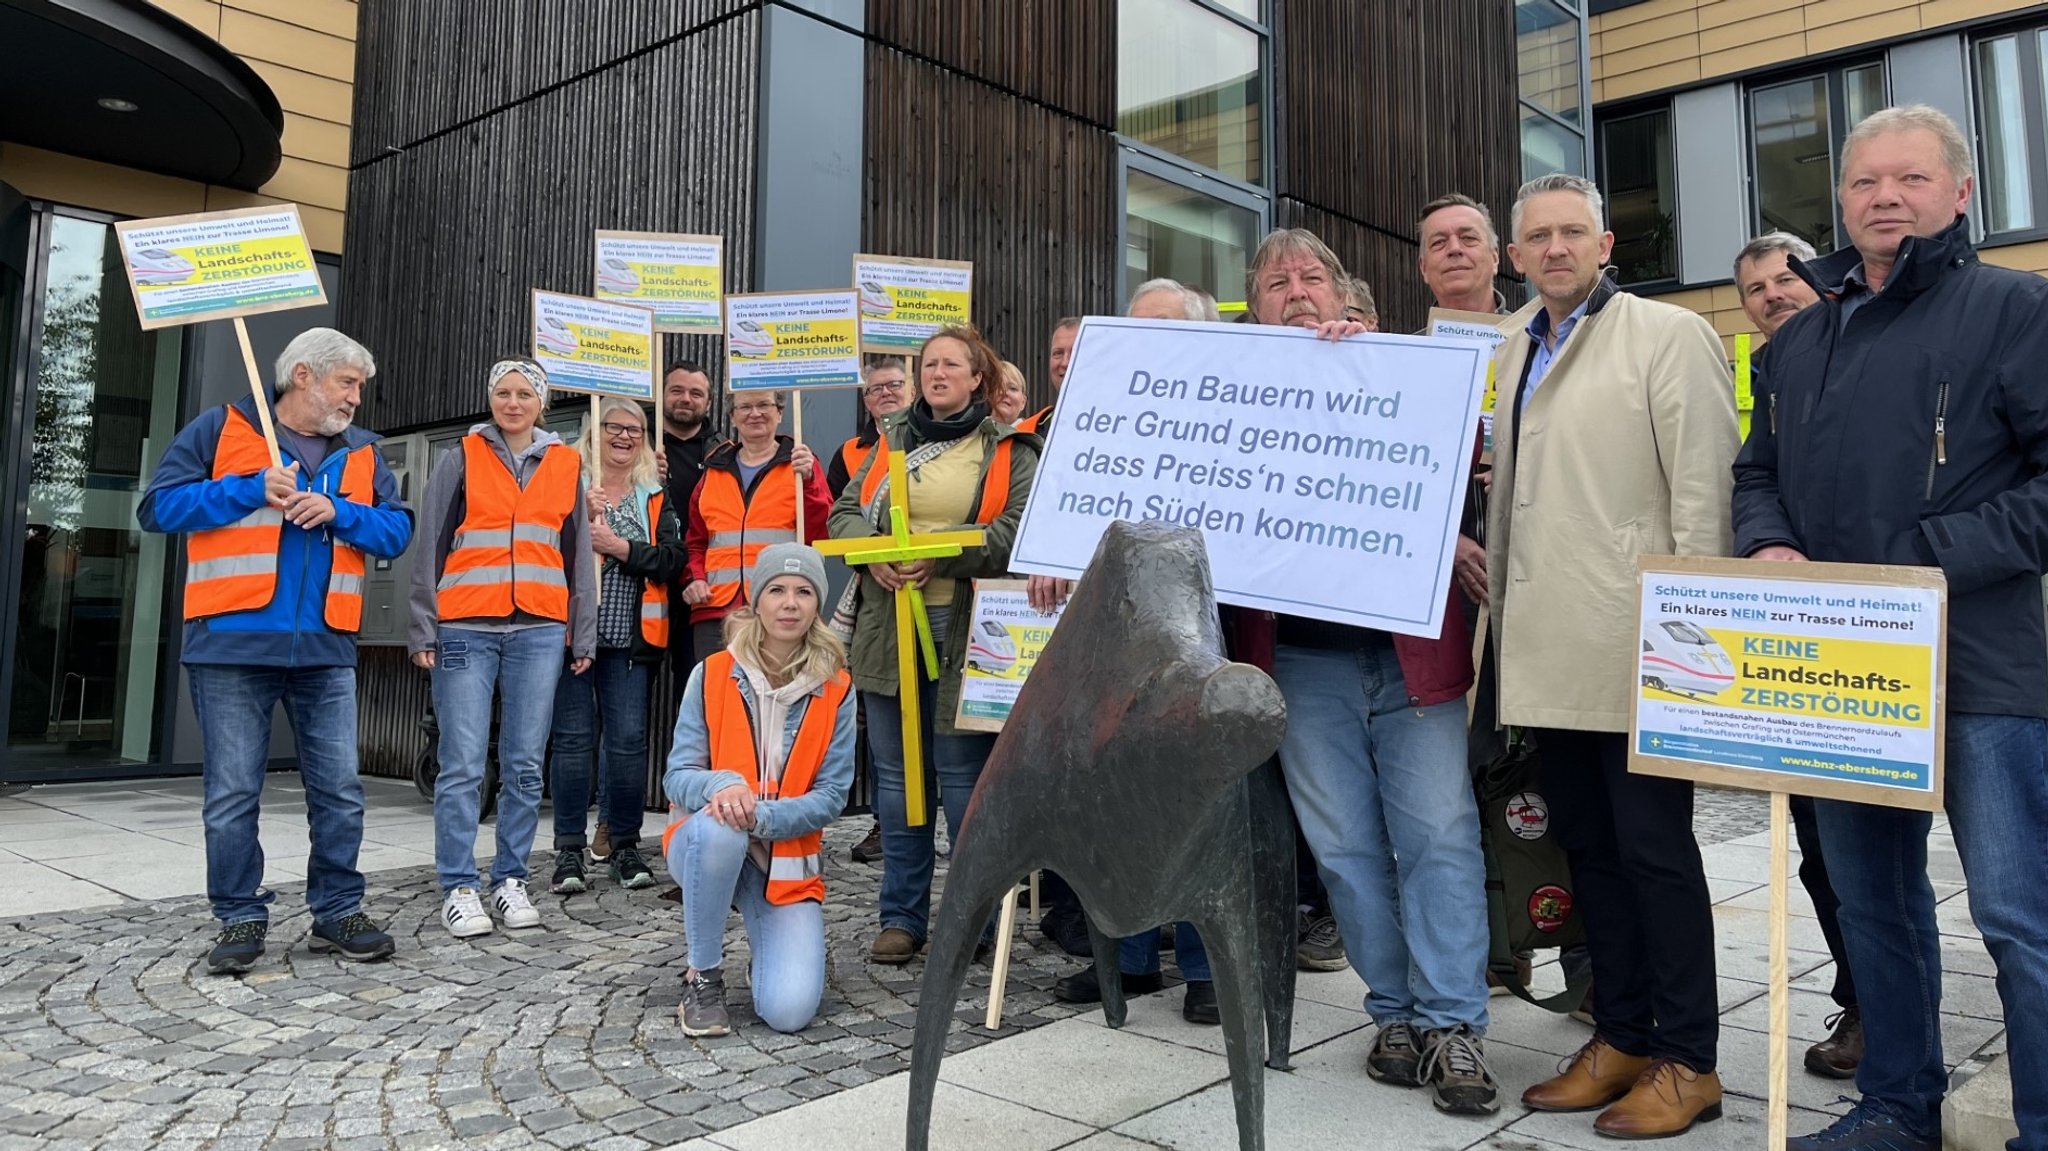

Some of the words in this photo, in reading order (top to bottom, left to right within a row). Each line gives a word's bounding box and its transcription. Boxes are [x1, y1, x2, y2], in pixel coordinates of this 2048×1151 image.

[128, 231, 164, 239] Schützt
[200, 223, 235, 231] Umwelt
[256, 217, 290, 225] Heimat!
[151, 237, 180, 245] klares
[223, 229, 252, 237] Trasse
[254, 225, 289, 233] Limone!
[194, 244, 242, 257] KEINE
[198, 249, 297, 269] Landschafts-
[200, 258, 307, 281] ZERSTÖRUNG
[643, 265, 675, 274] KEINE
[643, 277, 712, 287] Landschafts-
[643, 287, 716, 298] ZERSTÖRUNG
[897, 289, 928, 299] KEINE
[897, 300, 961, 312] Landschafts-
[580, 327, 610, 339] KEINE
[776, 323, 810, 333] KEINE
[1437, 325, 1474, 336] Schützt
[581, 339, 643, 356] Landschafts-
[777, 334, 848, 345] Landschafts-
[580, 349, 647, 368] ZERSTÖRUNG
[777, 344, 853, 357] ZERSTÖRUNG
[1128, 370, 1188, 400] Den
[1197, 376, 1314, 411] Bauern
[1325, 388, 1402, 420] wird
[1075, 405, 1128, 435] der
[1134, 410, 1232, 446] Grund
[1237, 426, 1440, 474] genommen,
[1073, 446, 1145, 478] dass
[1295, 472, 1424, 513] schnell
[1058, 491, 1133, 520] nach
[1142, 494, 1245, 535] Süden
[1254, 507, 1413, 559] kommen.
[981, 595, 1009, 604] Schützt
[1655, 586, 1707, 598] Schützt
[1711, 591, 1759, 602] unsere
[1764, 593, 1821, 606] Umwelt
[1827, 597, 1856, 608] und
[1861, 599, 1922, 613] Heimat!
[983, 608, 994, 616] Ein
[995, 608, 1018, 617] klares
[1020, 610, 1038, 619] NEIN
[1661, 603, 1683, 614] Ein
[1685, 605, 1727, 617] klares
[1731, 608, 1766, 621] NEIN
[1770, 613, 1793, 622] zur
[1798, 613, 1846, 626] Trasse
[1851, 617, 1914, 631] Limone!
[1024, 629, 1051, 642] KEIN
[1743, 637, 1819, 660] KEINE
[1743, 662, 1911, 694] Landschafts-
[1741, 684, 1921, 722] ZERSTÖRUNG
[1702, 710, 1764, 723] bestandsnahen
[1766, 717, 1798, 727] Ausbau
[1800, 721, 1815, 729] des
[1817, 722, 1901, 738] Brennernordzulaufs
[1704, 719, 1740, 729] zwischen
[1742, 723, 1772, 734] Grafing
[1793, 729, 1855, 742] Ostermünchen
[1680, 725, 1783, 745] landschaftsverträglich
[1795, 738, 1882, 755] umweltschonend
[1780, 755, 1918, 782] www.bnz-ebersberg.de
